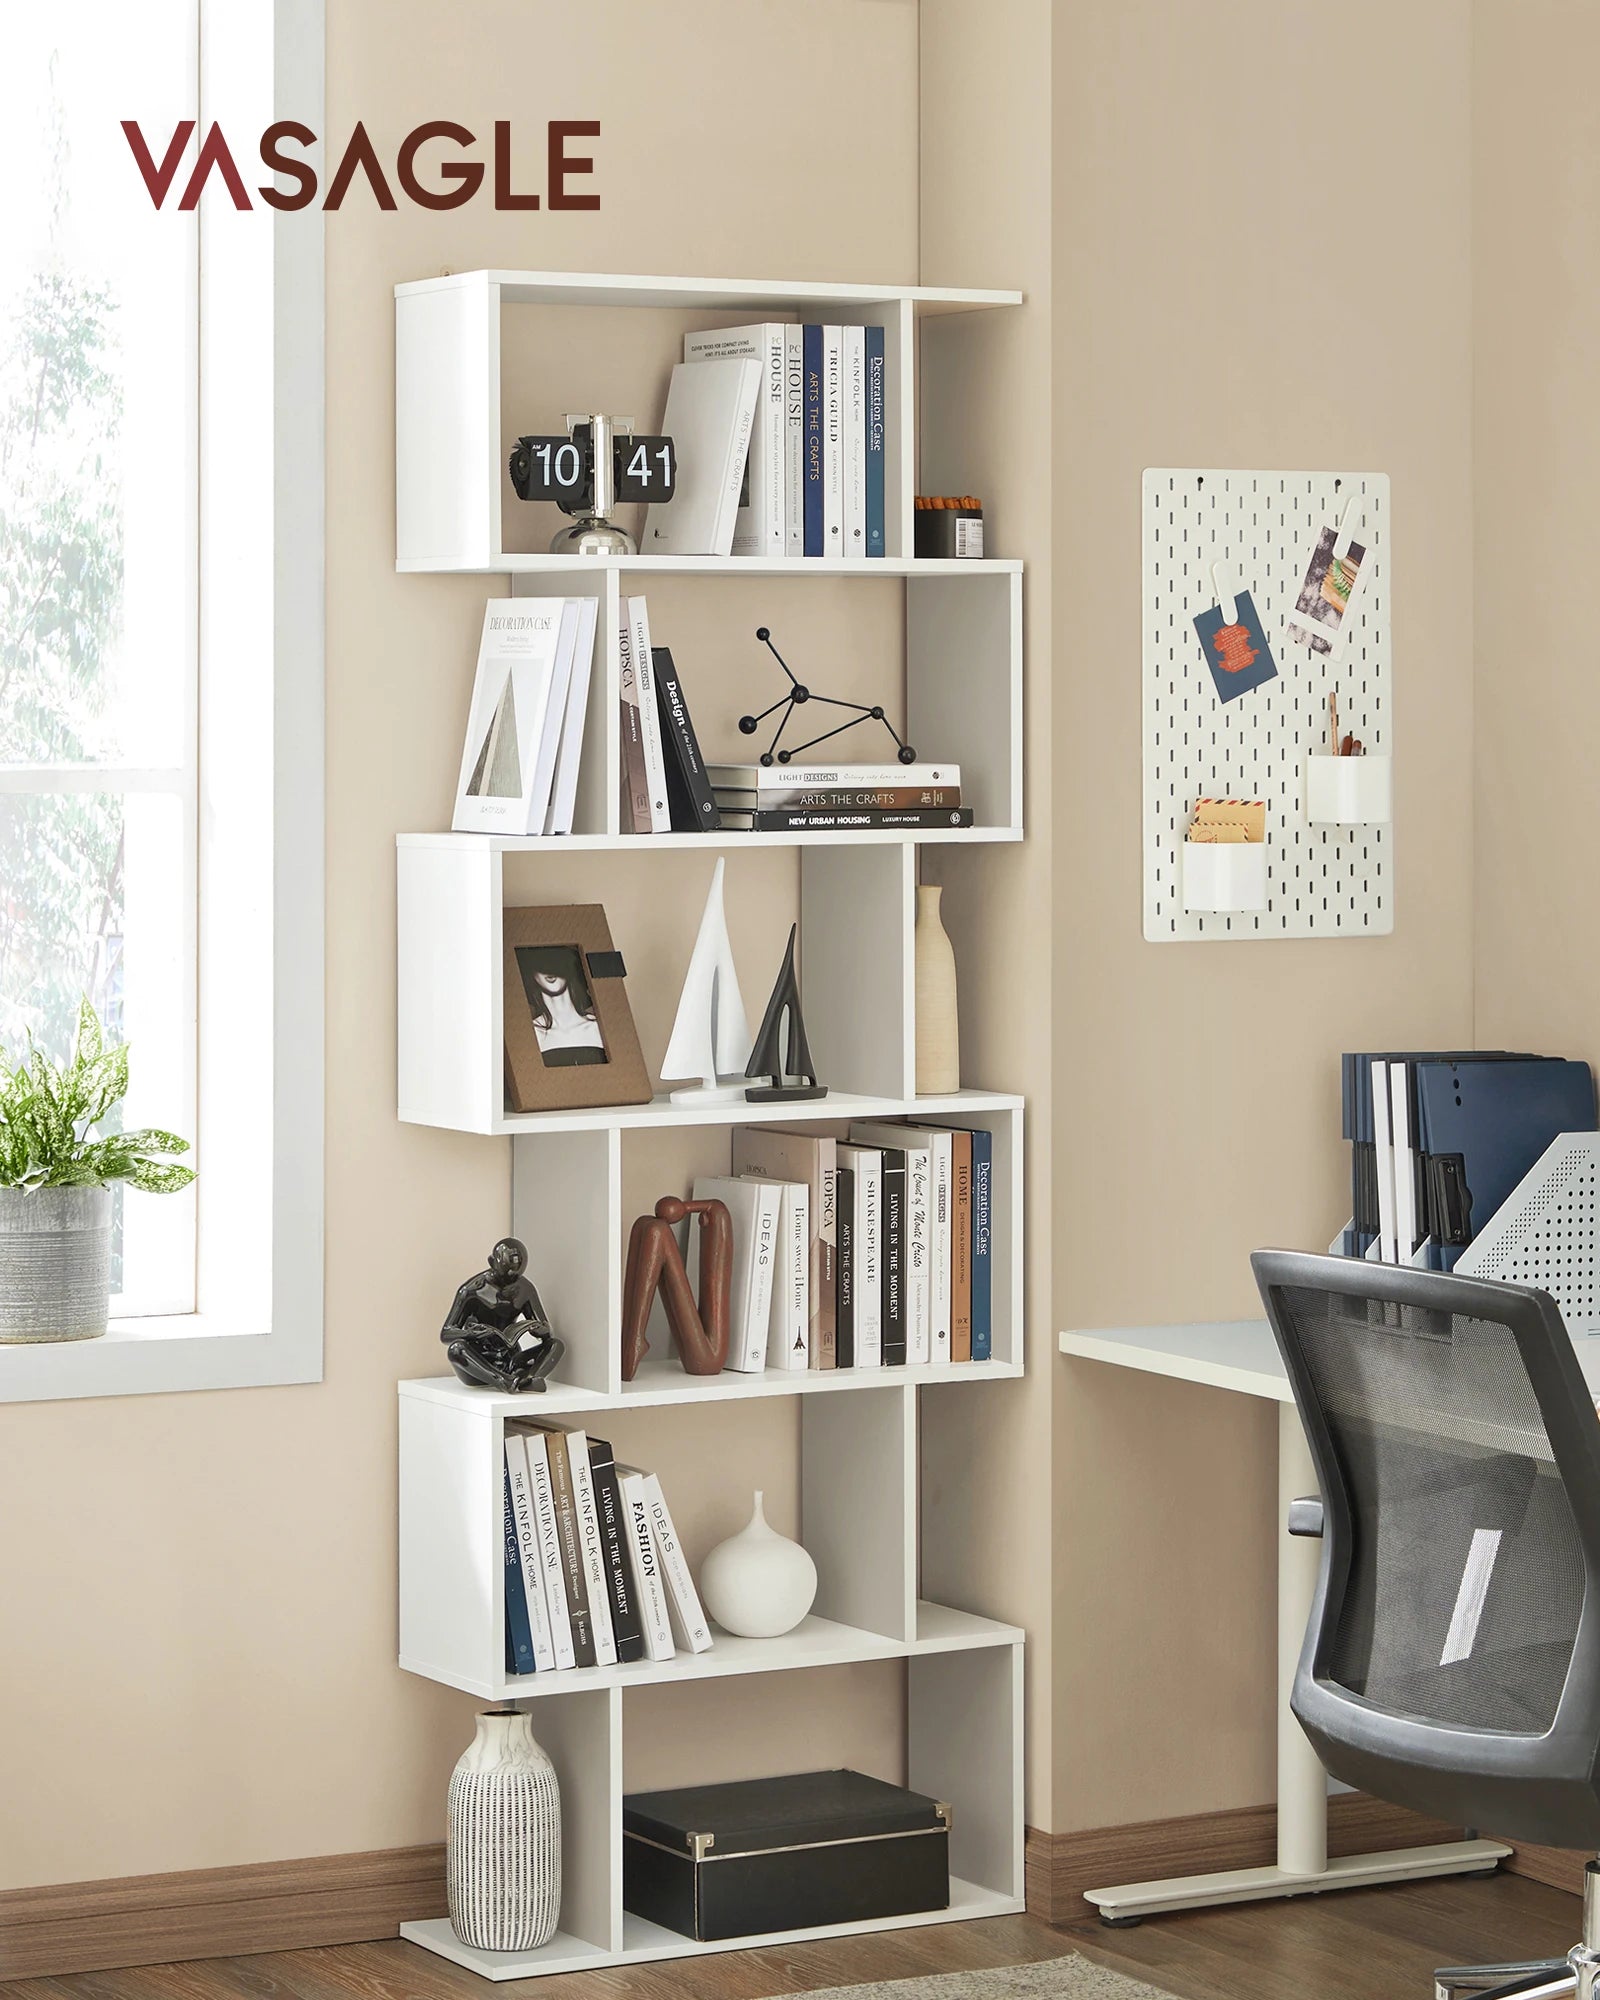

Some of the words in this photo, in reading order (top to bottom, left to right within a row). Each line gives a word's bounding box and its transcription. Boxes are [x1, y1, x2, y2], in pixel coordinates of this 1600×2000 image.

[789, 345, 800, 353] PC
[772, 346, 781, 403] HOUSE
[810, 372, 818, 402] ARTS
[873, 357, 883, 421] Decoration
[789, 359, 801, 427] HOUSE
[741, 410, 750, 432] ARTS
[810, 408, 818, 430] THE
[737, 438, 746, 454] THE
[874, 424, 883, 451] Case
[536, 444, 580, 486] 10
[627, 444, 672, 487] 41
[810, 436, 819, 481] CRAFTS
[731, 458, 742, 492] CRAFTS
[636, 622, 645, 648] LIGHT
[619, 629, 633, 688] HOPSCA
[639, 651, 650, 690] DESIGNS
[666, 680, 686, 726] Design
[804, 773, 838, 781] DESIGNS
[800, 793, 826, 805] ARTS
[831, 793, 851, 804] THE
[856, 793, 894, 804] CRAFTS
[837, 816, 870, 824] HOUSING
[915, 1157, 926, 1171] The
[824, 1170, 834, 1228] HOPSCA
[913, 1174, 926, 1196] Count
[959, 1166, 967, 1206] HOME
[980, 1162, 990, 1225] Decoration
[759, 1213, 771, 1265] IDEAS
[794, 1208, 804, 1241] Home
[890, 1234, 898, 1244] IN
[914, 1211, 925, 1238] Monte
[912, 1242, 925, 1267] Cristo
[980, 1228, 990, 1255] Case
[795, 1245, 803, 1273] sweet
[795, 1277, 804, 1310] Home
[514, 1472, 523, 1490] THE
[577, 1466, 587, 1484] THE
[534, 1462, 555, 1541] DECORATION
[560, 1494, 569, 1509] ART
[602, 1487, 615, 1524] LIVING
[516, 1494, 534, 1563] KINFOLK
[580, 1488, 598, 1557] KINFOLK
[608, 1528, 617, 1539] IN
[651, 1502, 674, 1553] IDEAS
[506, 1536, 517, 1565] Case
[563, 1516, 578, 1574] ARCHITECTURE
[610, 1542, 621, 1565] THE
[632, 1502, 655, 1577] FASHION
[544, 1542, 558, 1572] CASE
[590, 1558, 600, 1583] HOME
[527, 1565, 537, 1590] HOME
[613, 1570, 628, 1615] MOMENT
